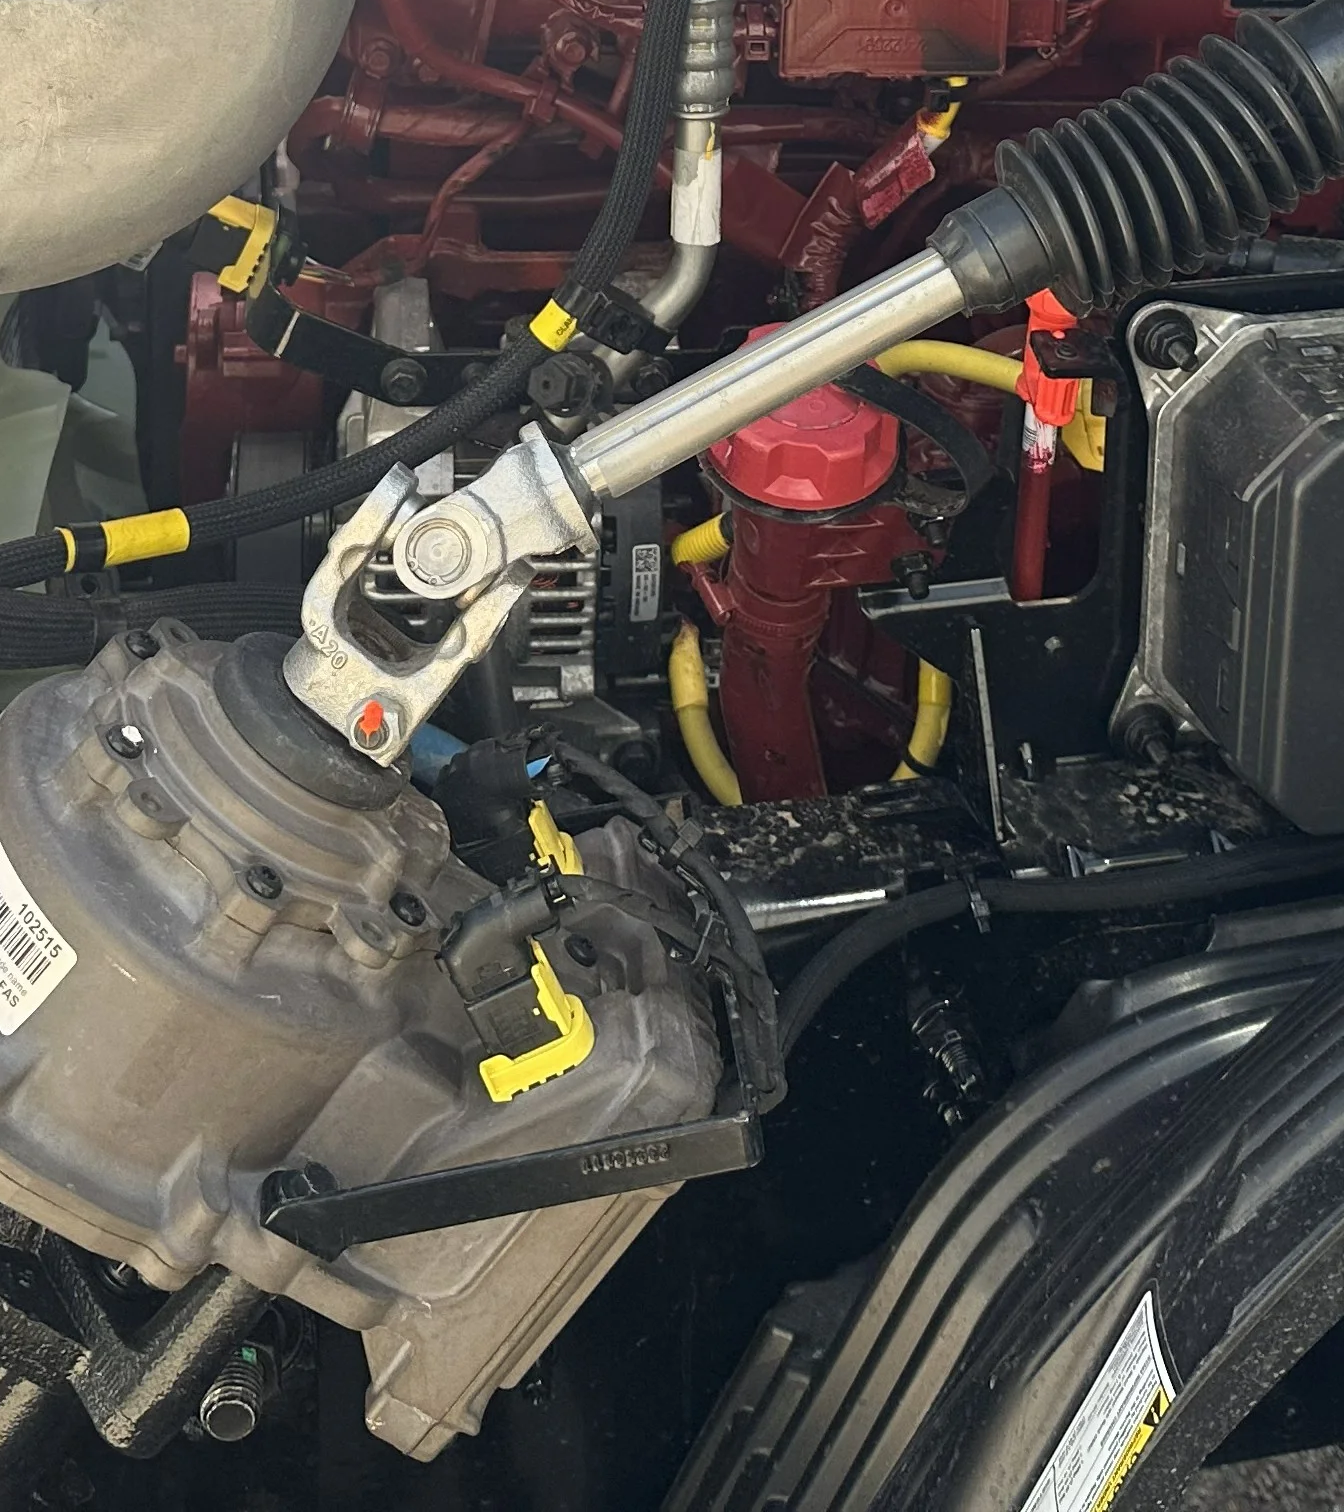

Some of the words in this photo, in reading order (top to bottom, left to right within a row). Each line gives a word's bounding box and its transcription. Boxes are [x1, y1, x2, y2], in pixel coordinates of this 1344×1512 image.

[311, 624, 348, 669] A20
[18, 903, 63, 959] 102515
[6, 972, 28, 997] name
